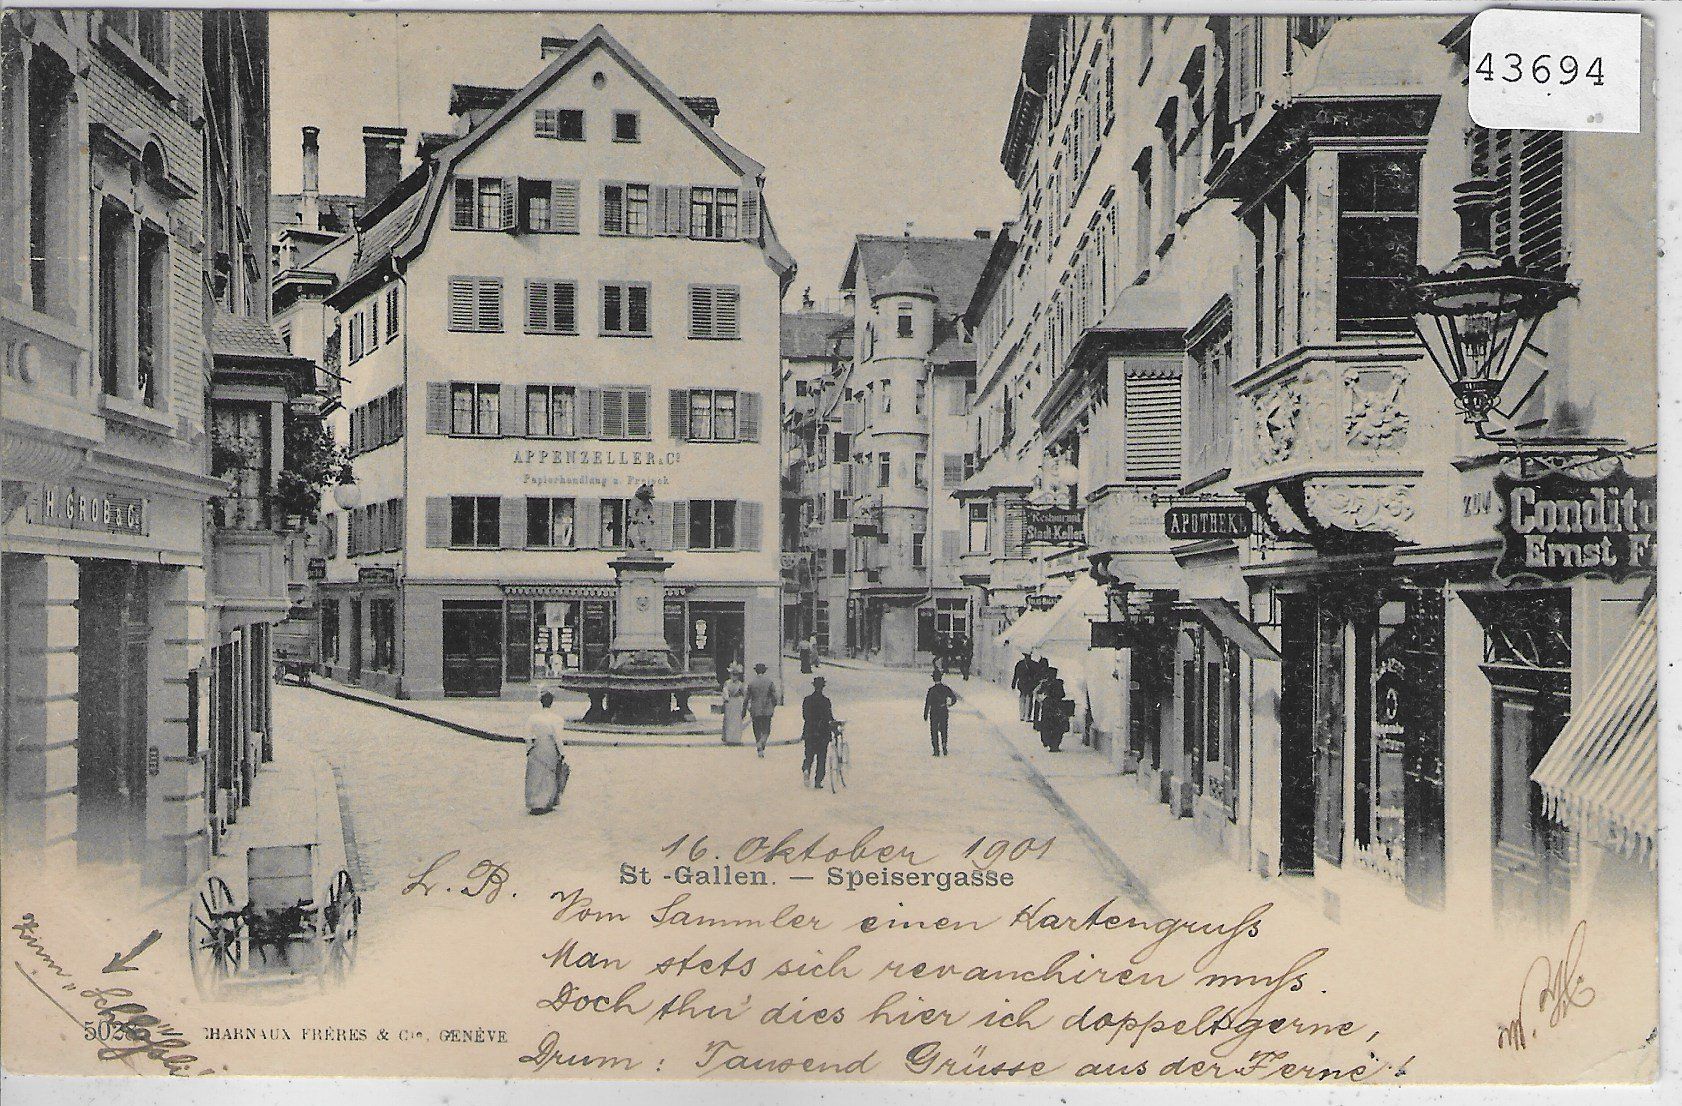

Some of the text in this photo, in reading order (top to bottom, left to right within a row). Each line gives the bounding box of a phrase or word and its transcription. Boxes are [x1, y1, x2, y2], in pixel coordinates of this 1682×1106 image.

[1475, 51, 1605, 86] 43694
[513, 450, 655, 465] APPENZELLER
[66, 493, 110, 524] GROB
[1171, 513, 1247, 533] APOTHEKE
[1510, 487, 1657, 533] Condito
[1524, 535, 1618, 567] Ernst
[733, 825, 938, 865] Oktober
[962, 836, 1057, 870] 1901
[550, 888, 631, 923] Vom
[650, 893, 833, 931] Sammler
[852, 903, 1001, 933] einen
[541, 938, 631, 970] Man
[646, 944, 757, 977] stets
[761, 944, 863, 981] sich
[536, 981, 655, 1016] Doch
[759, 996, 846, 1025] dies
[858, 990, 971, 1027] hier
[967, 997, 1054, 1031] ich
[695, 1040, 882, 1078] Tausend
[904, 1040, 1068, 1077] Grüsse
[1074, 1060, 1147, 1079] aus
[1160, 1061, 1238, 1080] der
